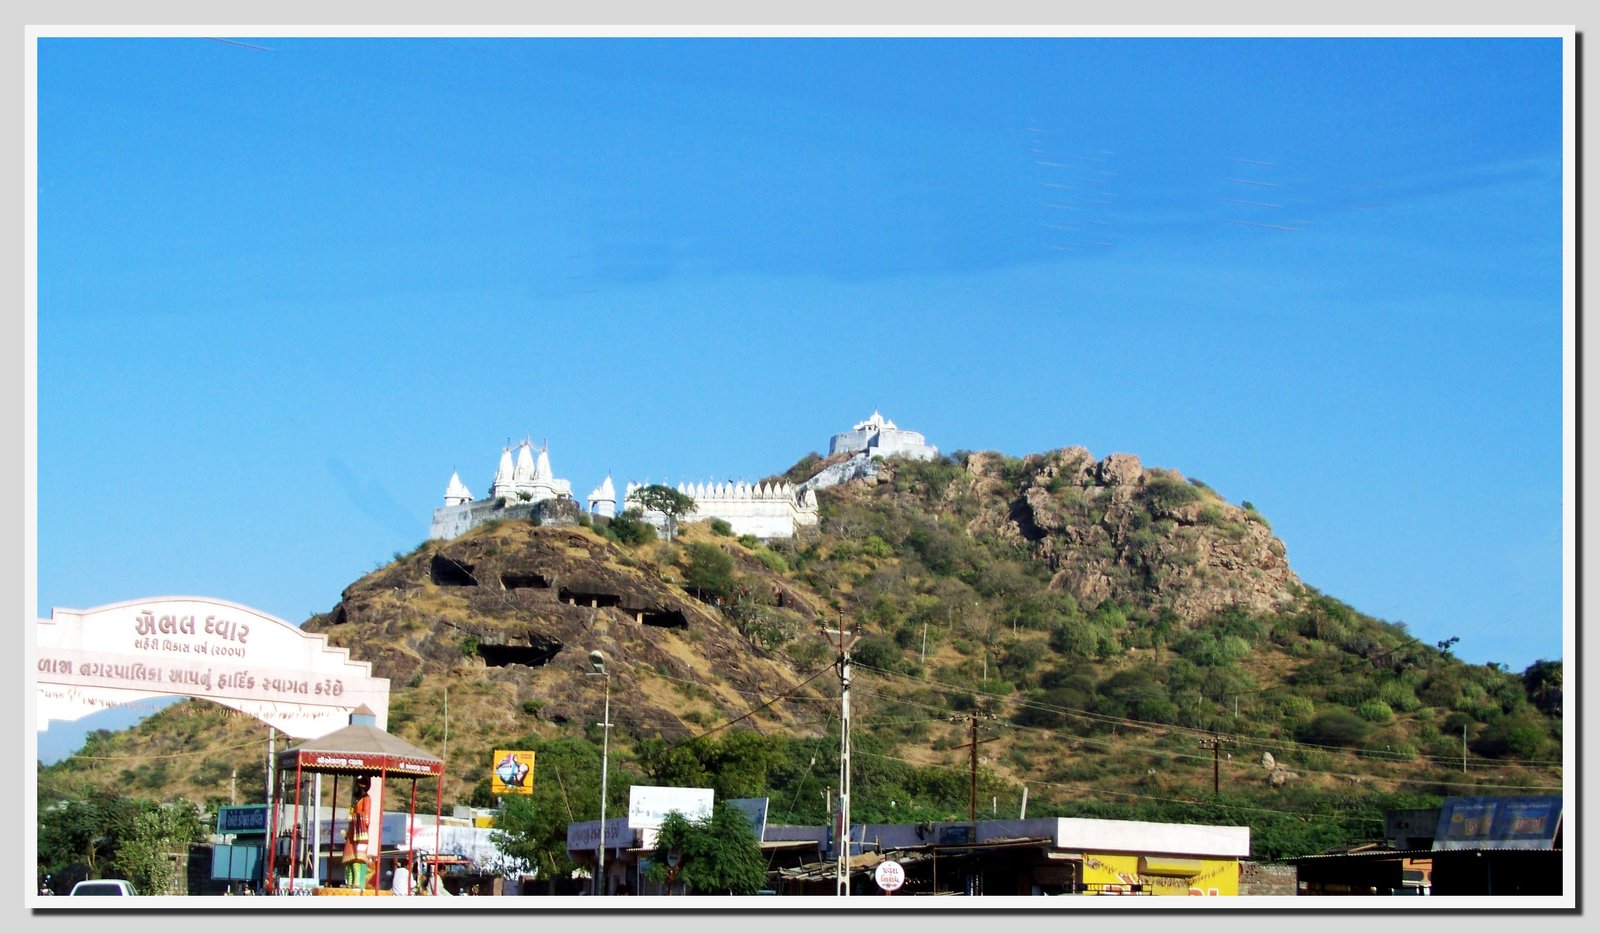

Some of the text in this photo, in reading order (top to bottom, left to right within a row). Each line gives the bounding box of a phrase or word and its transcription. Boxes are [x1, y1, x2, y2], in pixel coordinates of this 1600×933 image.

[162, 639, 190, 653] વિકાસ
[194, 641, 208, 654] વર્ષ
[79, 661, 163, 682] નગરપાલિકા
[168, 668, 212, 690] આપનું
[217, 670, 256, 689] હાર્દિક
[262, 677, 309, 695] સ્વાગત
